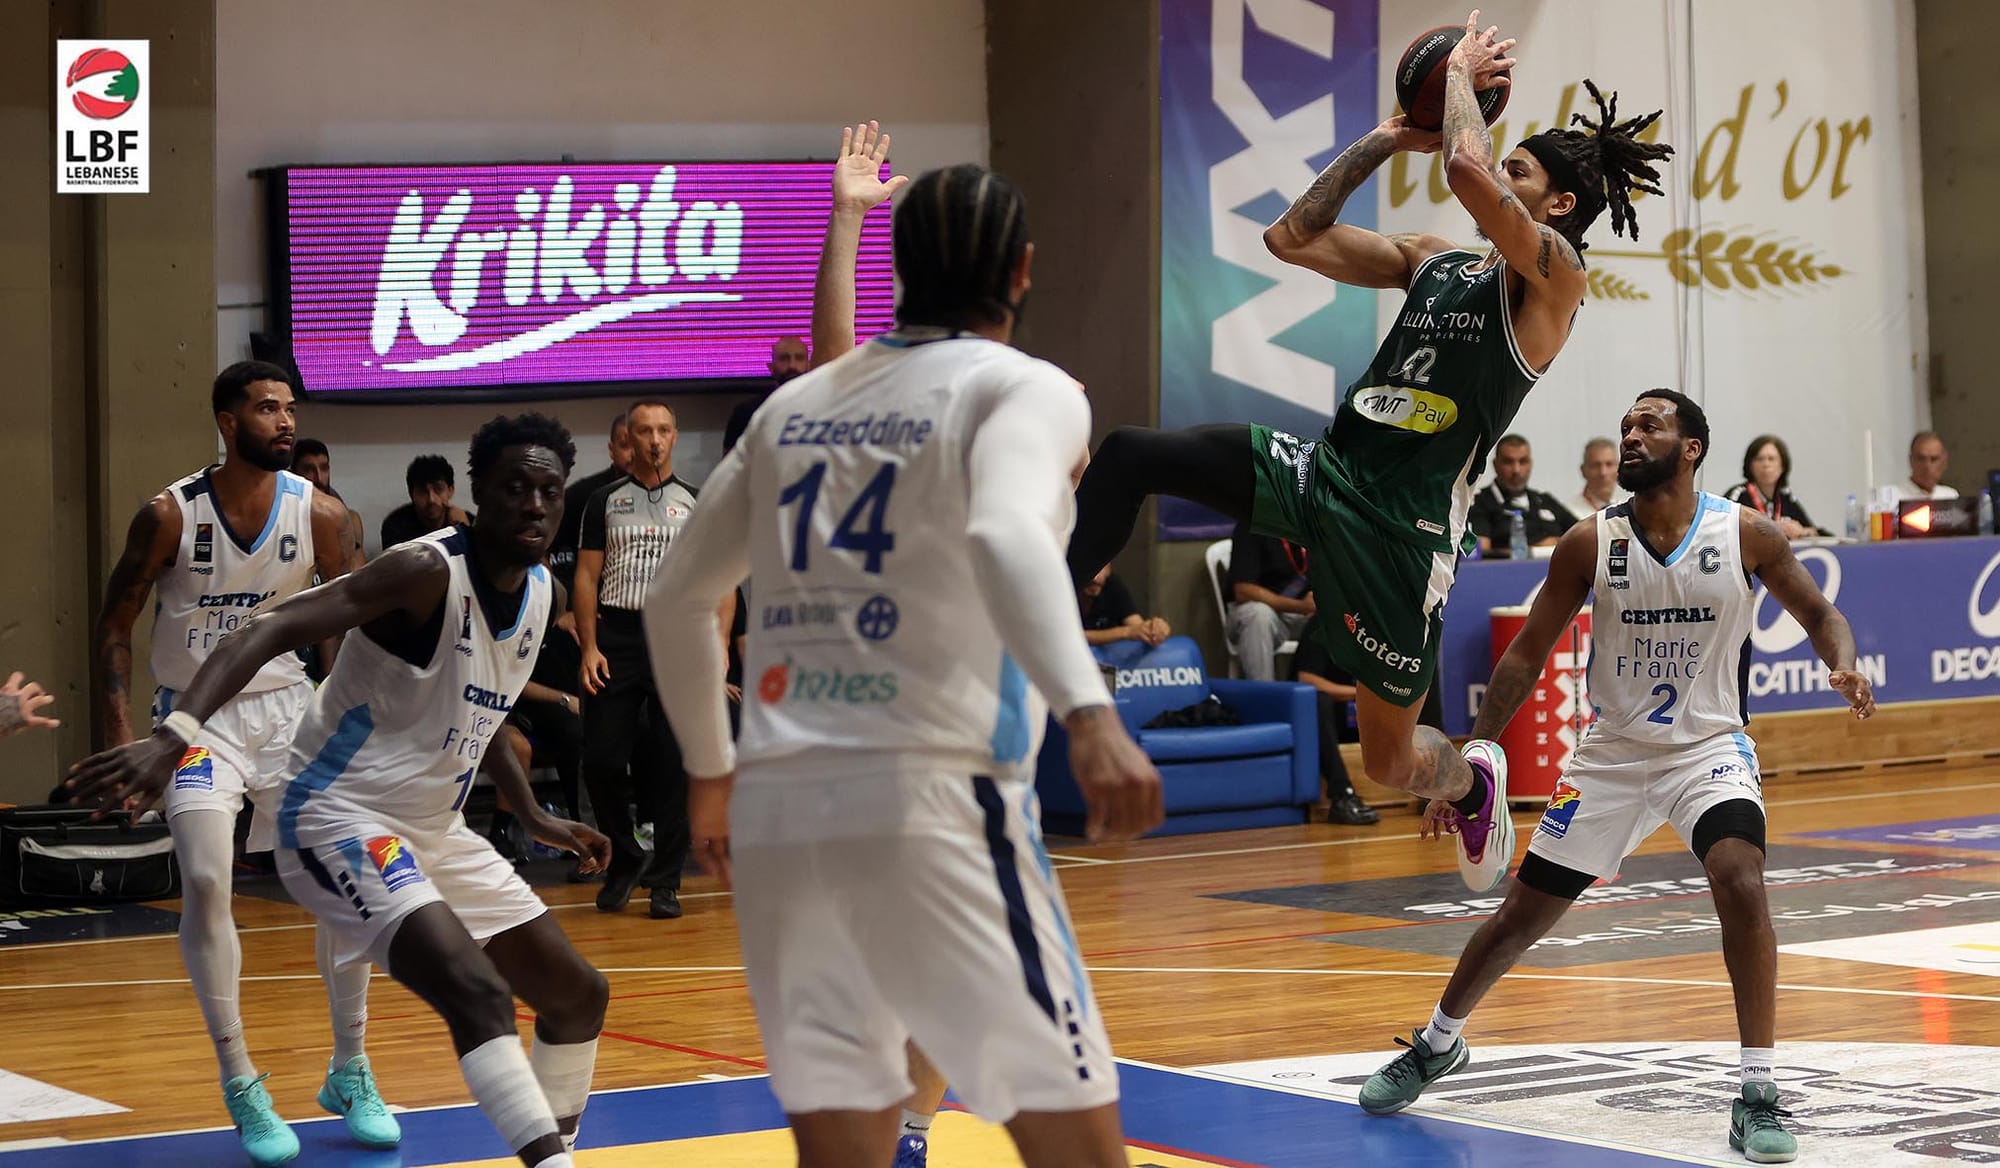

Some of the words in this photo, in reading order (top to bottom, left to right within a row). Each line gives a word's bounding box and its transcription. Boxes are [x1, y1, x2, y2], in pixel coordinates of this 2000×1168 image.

[1692, 78, 1873, 202] d'or
[371, 164, 744, 356] Krikita
[1415, 401, 1447, 428] Pay
[778, 413, 932, 446] Ezzeddine
[779, 461, 896, 574] 14
[279, 534, 297, 563] C
[1611, 559, 1625, 567] FIBA
[1699, 546, 1720, 575] C
[1621, 607, 1716, 625] CENTRAL
[1357, 626, 1422, 674] toters
[1635, 638, 1700, 658] Marie
[1617, 656, 1704, 678] Franc
[1382, 680, 1412, 696] capelli
[1647, 684, 1678, 725] 2
